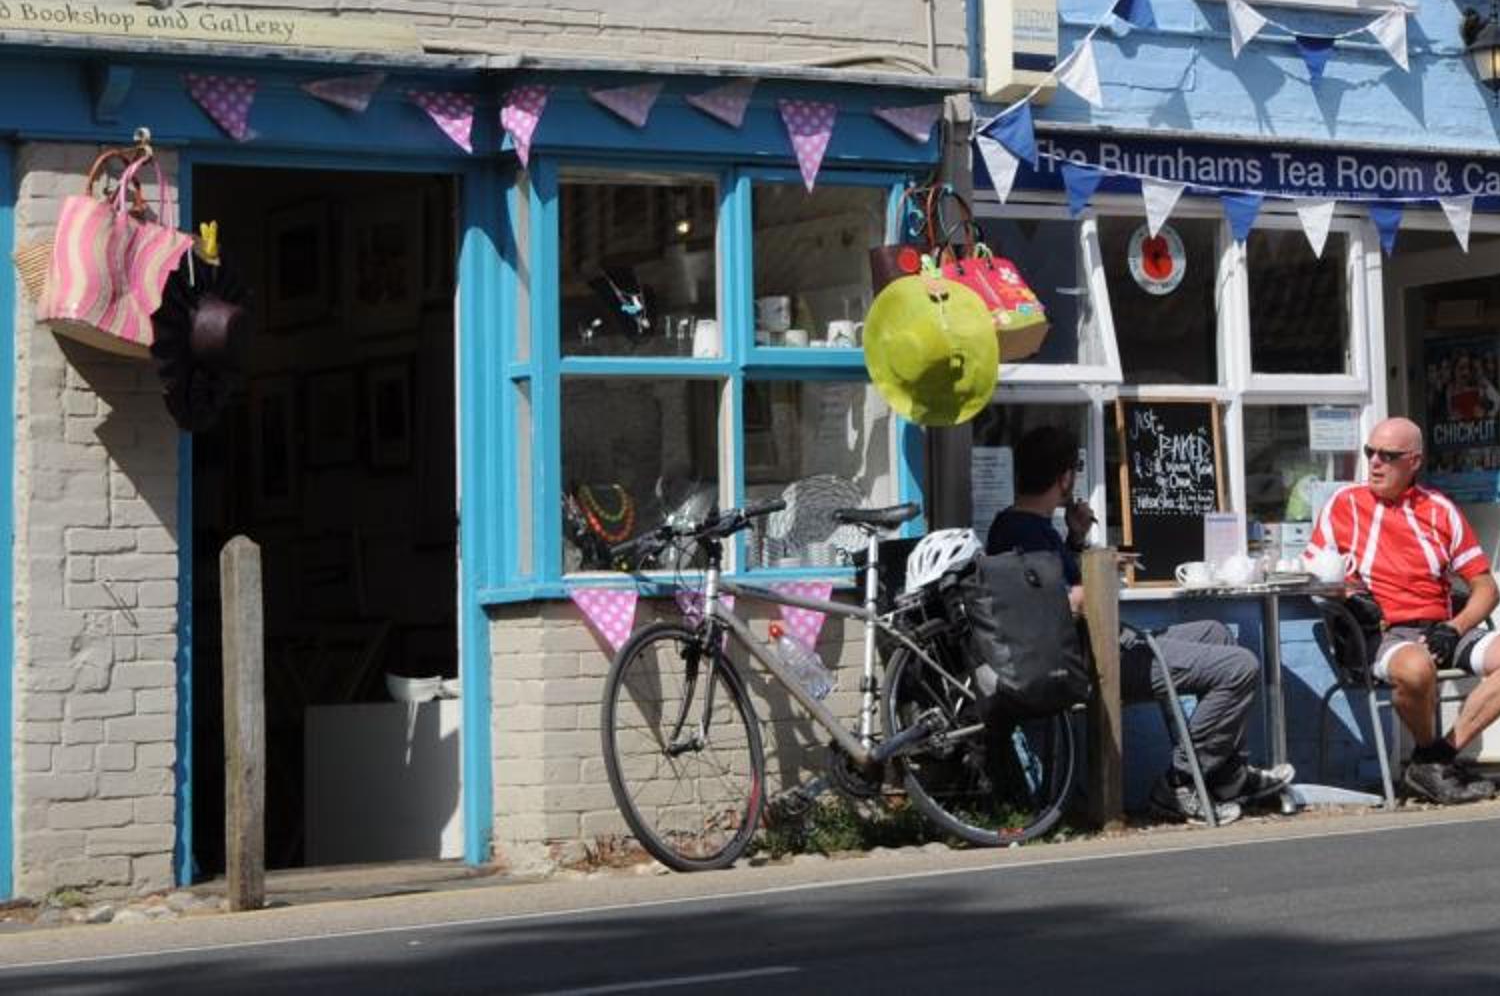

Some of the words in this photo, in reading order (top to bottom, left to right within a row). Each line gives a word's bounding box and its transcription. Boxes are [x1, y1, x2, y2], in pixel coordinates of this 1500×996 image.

[20, 3, 135, 32] Bookshop
[147, 10, 189, 31] and
[199, 12, 297, 44] Gallery
[1100, 143, 1263, 185] Burnhams
[1271, 153, 1326, 188] Tea
[1336, 155, 1424, 193] Room
[1433, 161, 1454, 194] &
